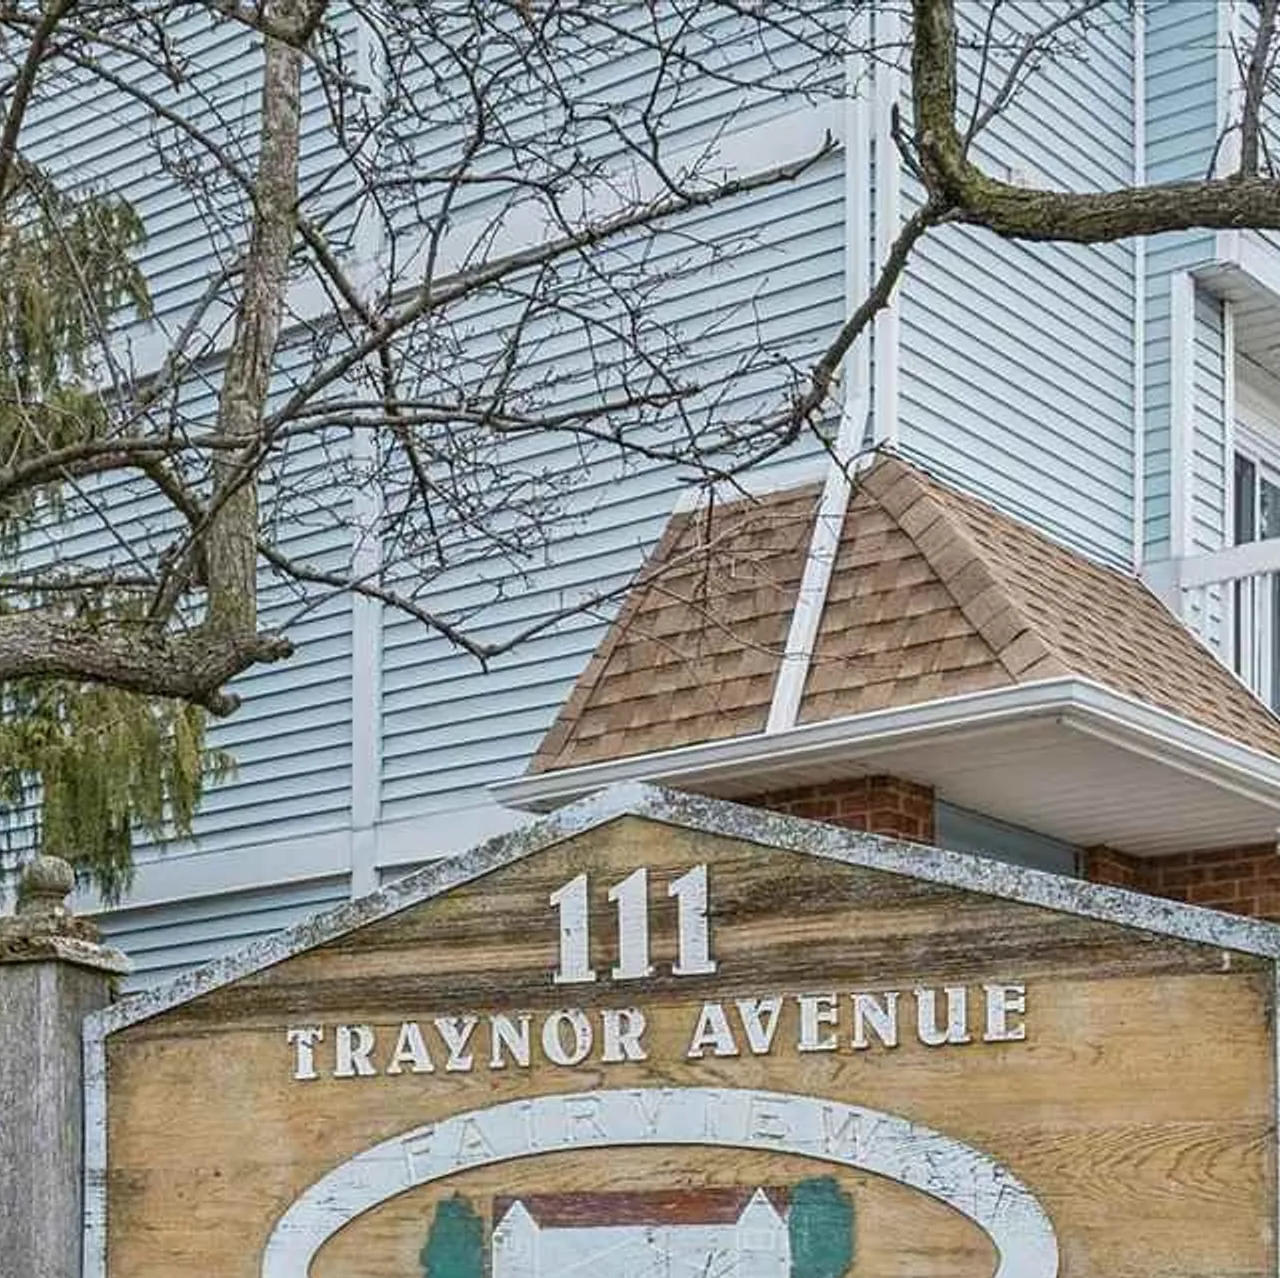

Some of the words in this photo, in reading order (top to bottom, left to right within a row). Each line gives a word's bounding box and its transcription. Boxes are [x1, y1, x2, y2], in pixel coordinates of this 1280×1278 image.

[549, 863, 719, 985] 111
[286, 1004, 650, 1082] TRAYNOR
[687, 983, 1028, 1060] AVENUE
[400, 1088, 888, 1186] FAIRVIEW
